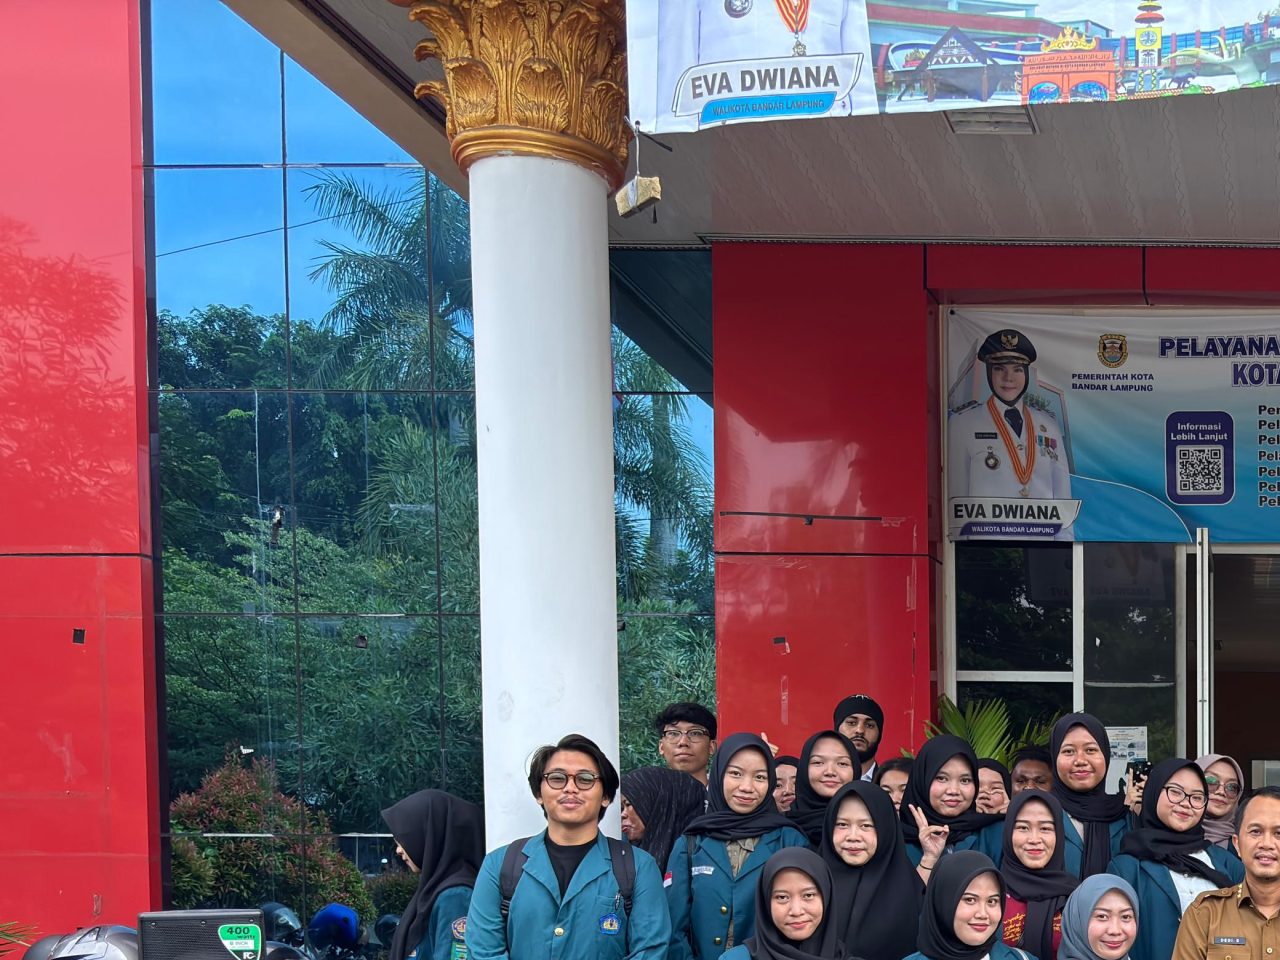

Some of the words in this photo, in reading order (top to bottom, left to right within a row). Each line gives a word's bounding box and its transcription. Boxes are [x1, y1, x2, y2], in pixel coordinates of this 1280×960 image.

[691, 72, 733, 99] EVA
[740, 66, 839, 92] DWIANA
[712, 104, 750, 116] WALIKOTA
[752, 101, 783, 111] BANDAR
[786, 99, 824, 109] LAMPUNG
[1072, 383, 1108, 391] BANDAR
[1110, 384, 1153, 392] LAMPUNG
[1177, 422, 1221, 431] Informasi
[1171, 432, 1196, 441] Lebih
[1198, 432, 1228, 442] Lanjut
[954, 504, 987, 518] EVA
[992, 504, 1060, 520] DWIANA
[227, 927, 250, 935] 400
